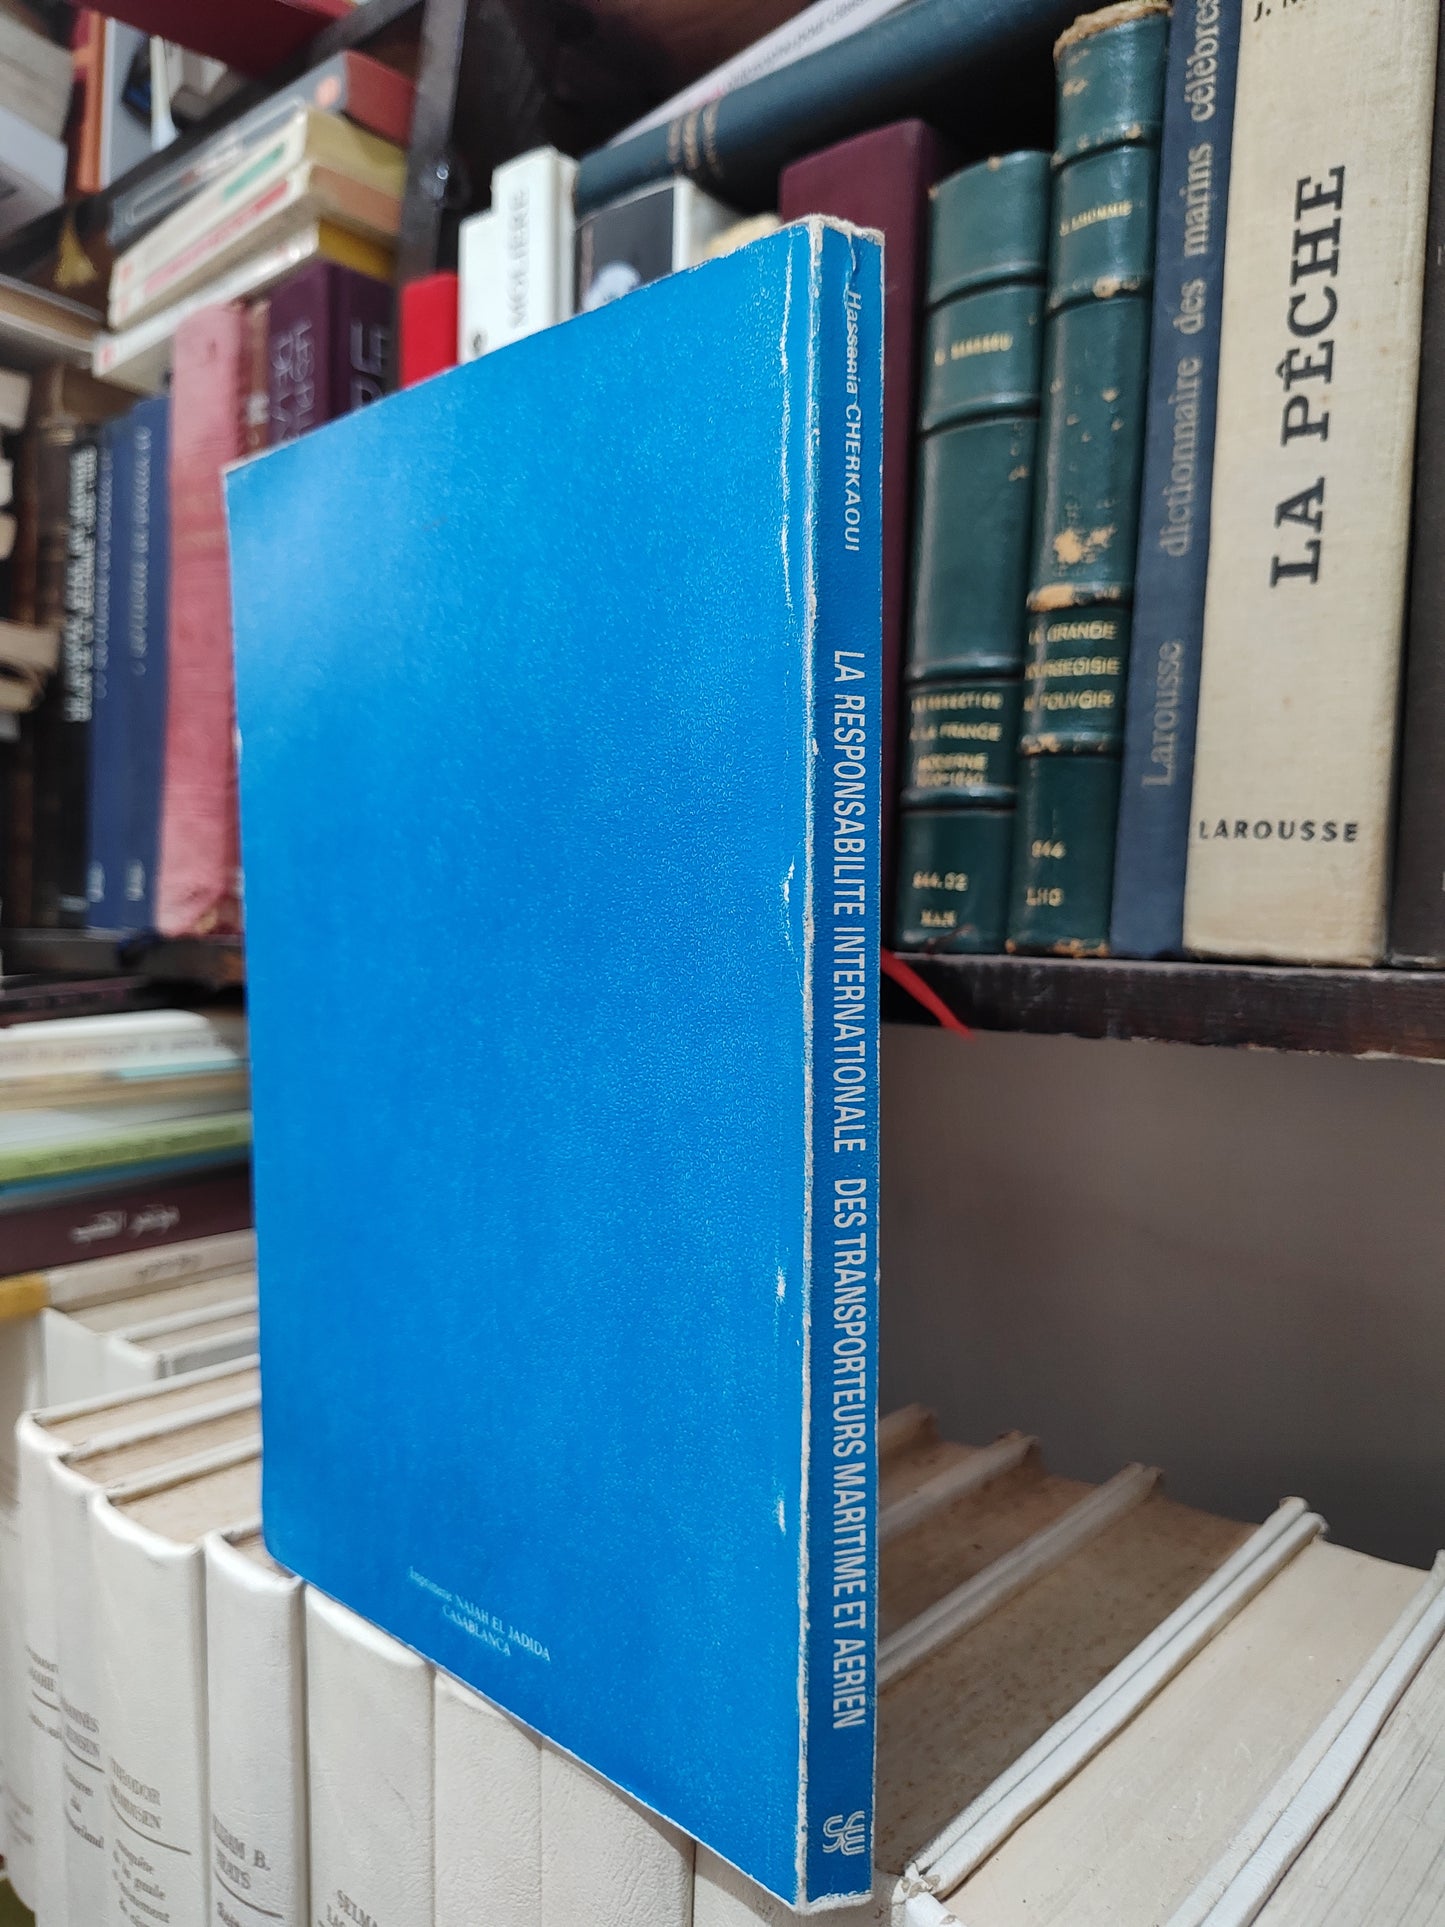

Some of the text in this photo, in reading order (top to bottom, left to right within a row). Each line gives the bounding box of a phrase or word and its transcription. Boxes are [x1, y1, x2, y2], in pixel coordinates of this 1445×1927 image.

[1179, 141, 1212, 257] marins
[1172, 277, 1208, 336] des
[1270, 165, 1346, 589] LA PÊCHE
[844, 404, 862, 552] CHERKAOUI
[1160, 355, 1202, 557] dictionnaire
[1141, 640, 1184, 788] Larousse
[1199, 819, 1358, 843] LAROUSSE
[832, 650, 867, 1730] LA RESPONSABILITE INTERNATIONALE DES TRANSPORTEURS MARITIME ET AERIEN
[441, 1604, 512, 1657] CASABLANCA
[492, 1615, 506, 1635] EL
[508, 1624, 551, 1662] JADIDA
[253, 1849, 271, 1872] B.
